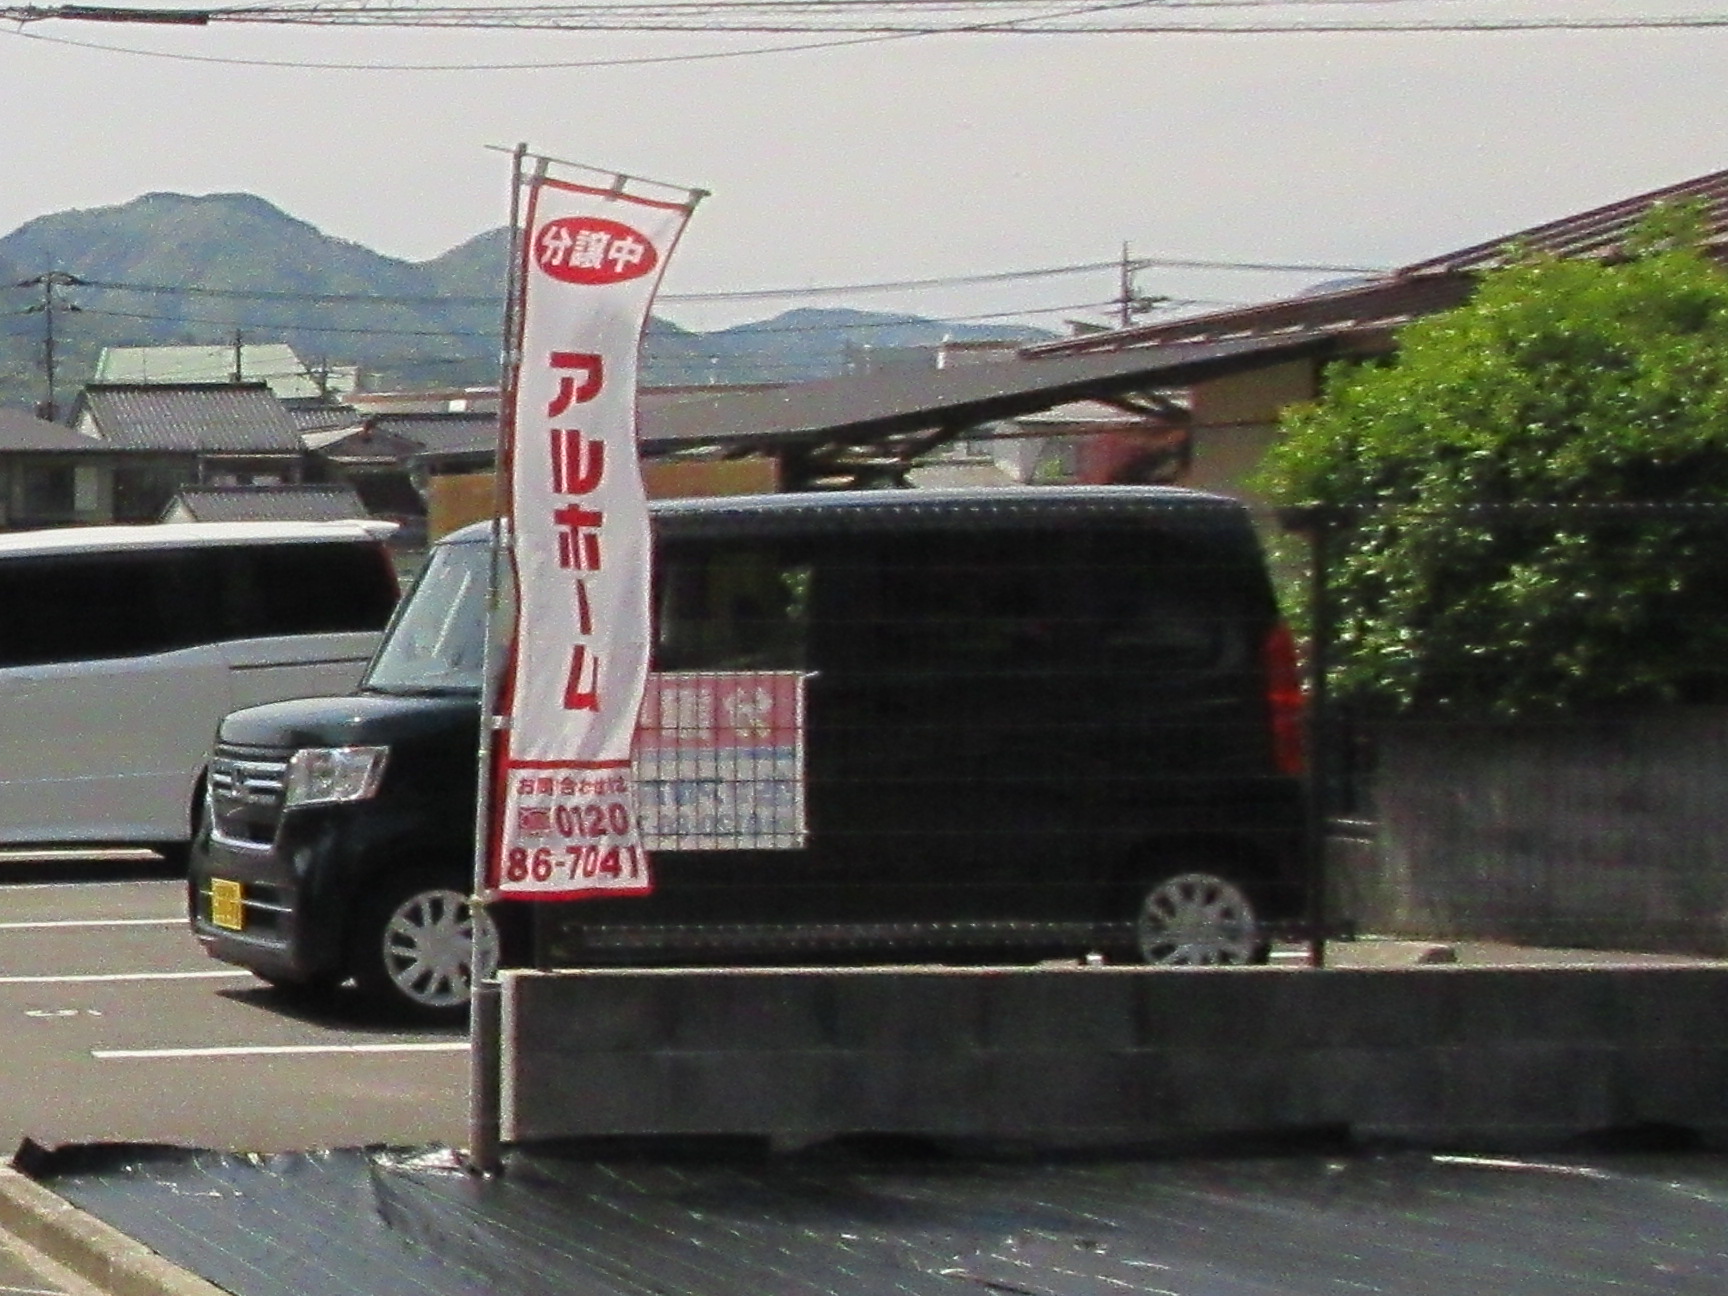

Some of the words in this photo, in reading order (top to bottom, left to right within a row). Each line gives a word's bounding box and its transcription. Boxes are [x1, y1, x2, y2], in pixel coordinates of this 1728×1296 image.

[540, 225, 645, 273] 分譲中
[547, 351, 606, 712] アルホーム
[554, 803, 630, 838] 0120
[505, 845, 639, 883] 86-7041
